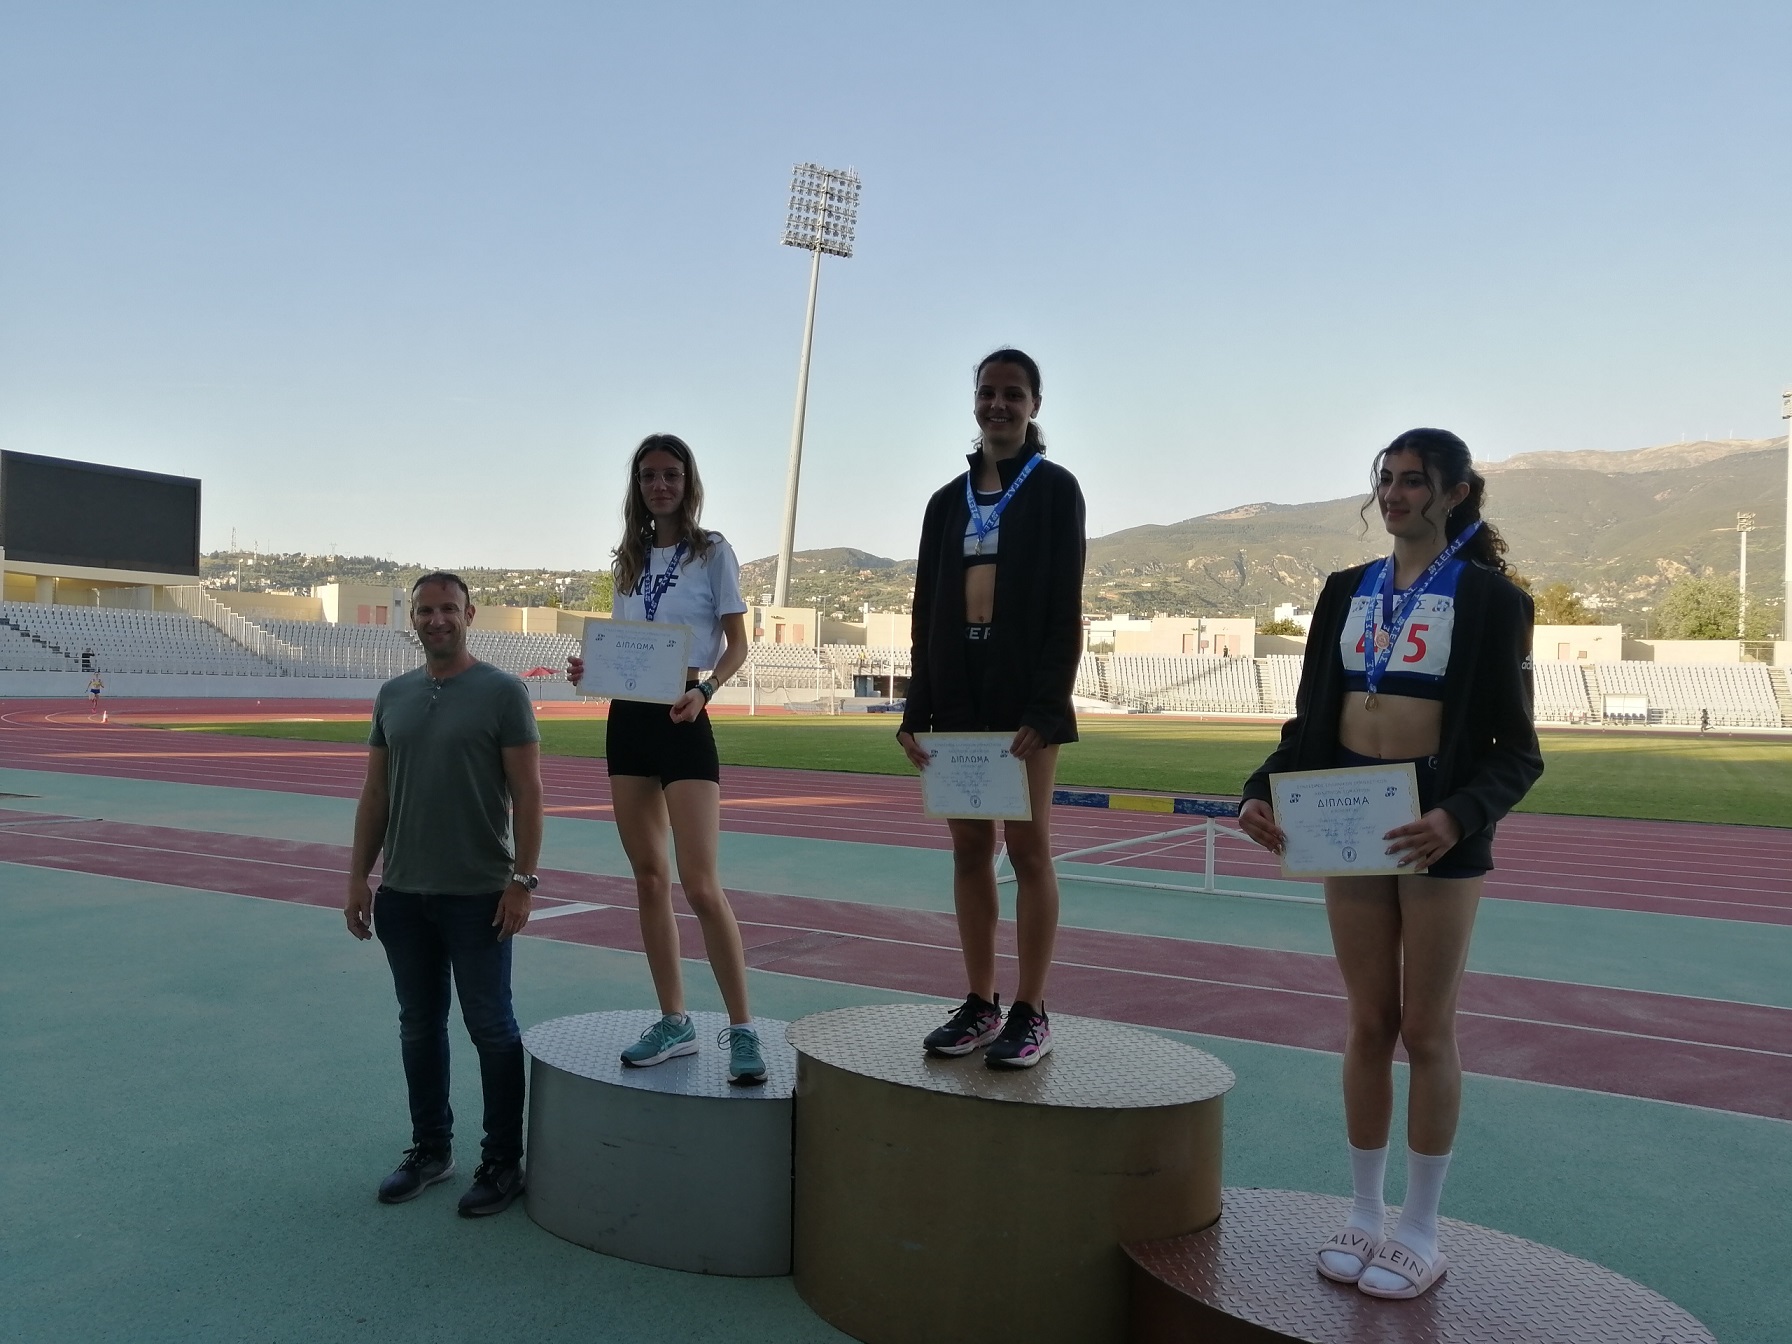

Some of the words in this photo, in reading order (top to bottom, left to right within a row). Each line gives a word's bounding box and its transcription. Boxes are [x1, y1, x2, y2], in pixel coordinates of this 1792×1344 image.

[615, 641, 655, 652] ΔΙΠΛΩΜΑ
[950, 755, 990, 764] ΔΙΠΛΩΜΑ
[1317, 796, 1370, 808] ΔΙΠΛΩΜΑ
